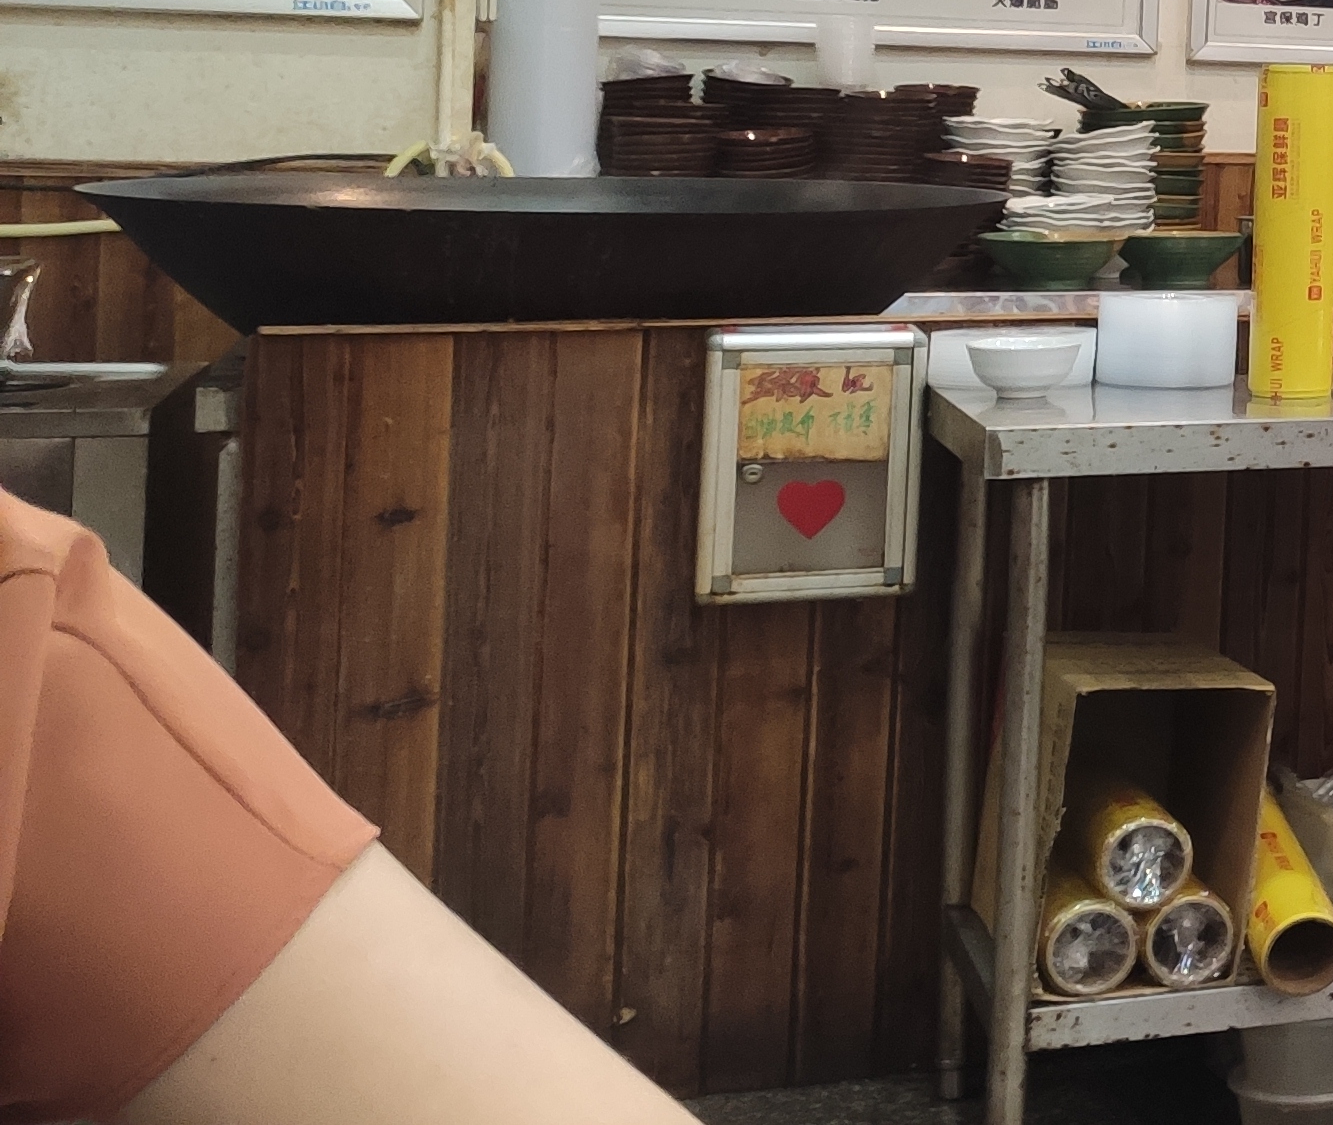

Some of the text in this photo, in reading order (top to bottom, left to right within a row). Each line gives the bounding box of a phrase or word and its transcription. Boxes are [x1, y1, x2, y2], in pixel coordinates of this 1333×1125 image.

[1263, 10, 1326, 27] 宫保鸡丁
[1309, 208, 1323, 284] YAHUI WRAP
[1270, 336, 1284, 373] WRAP
